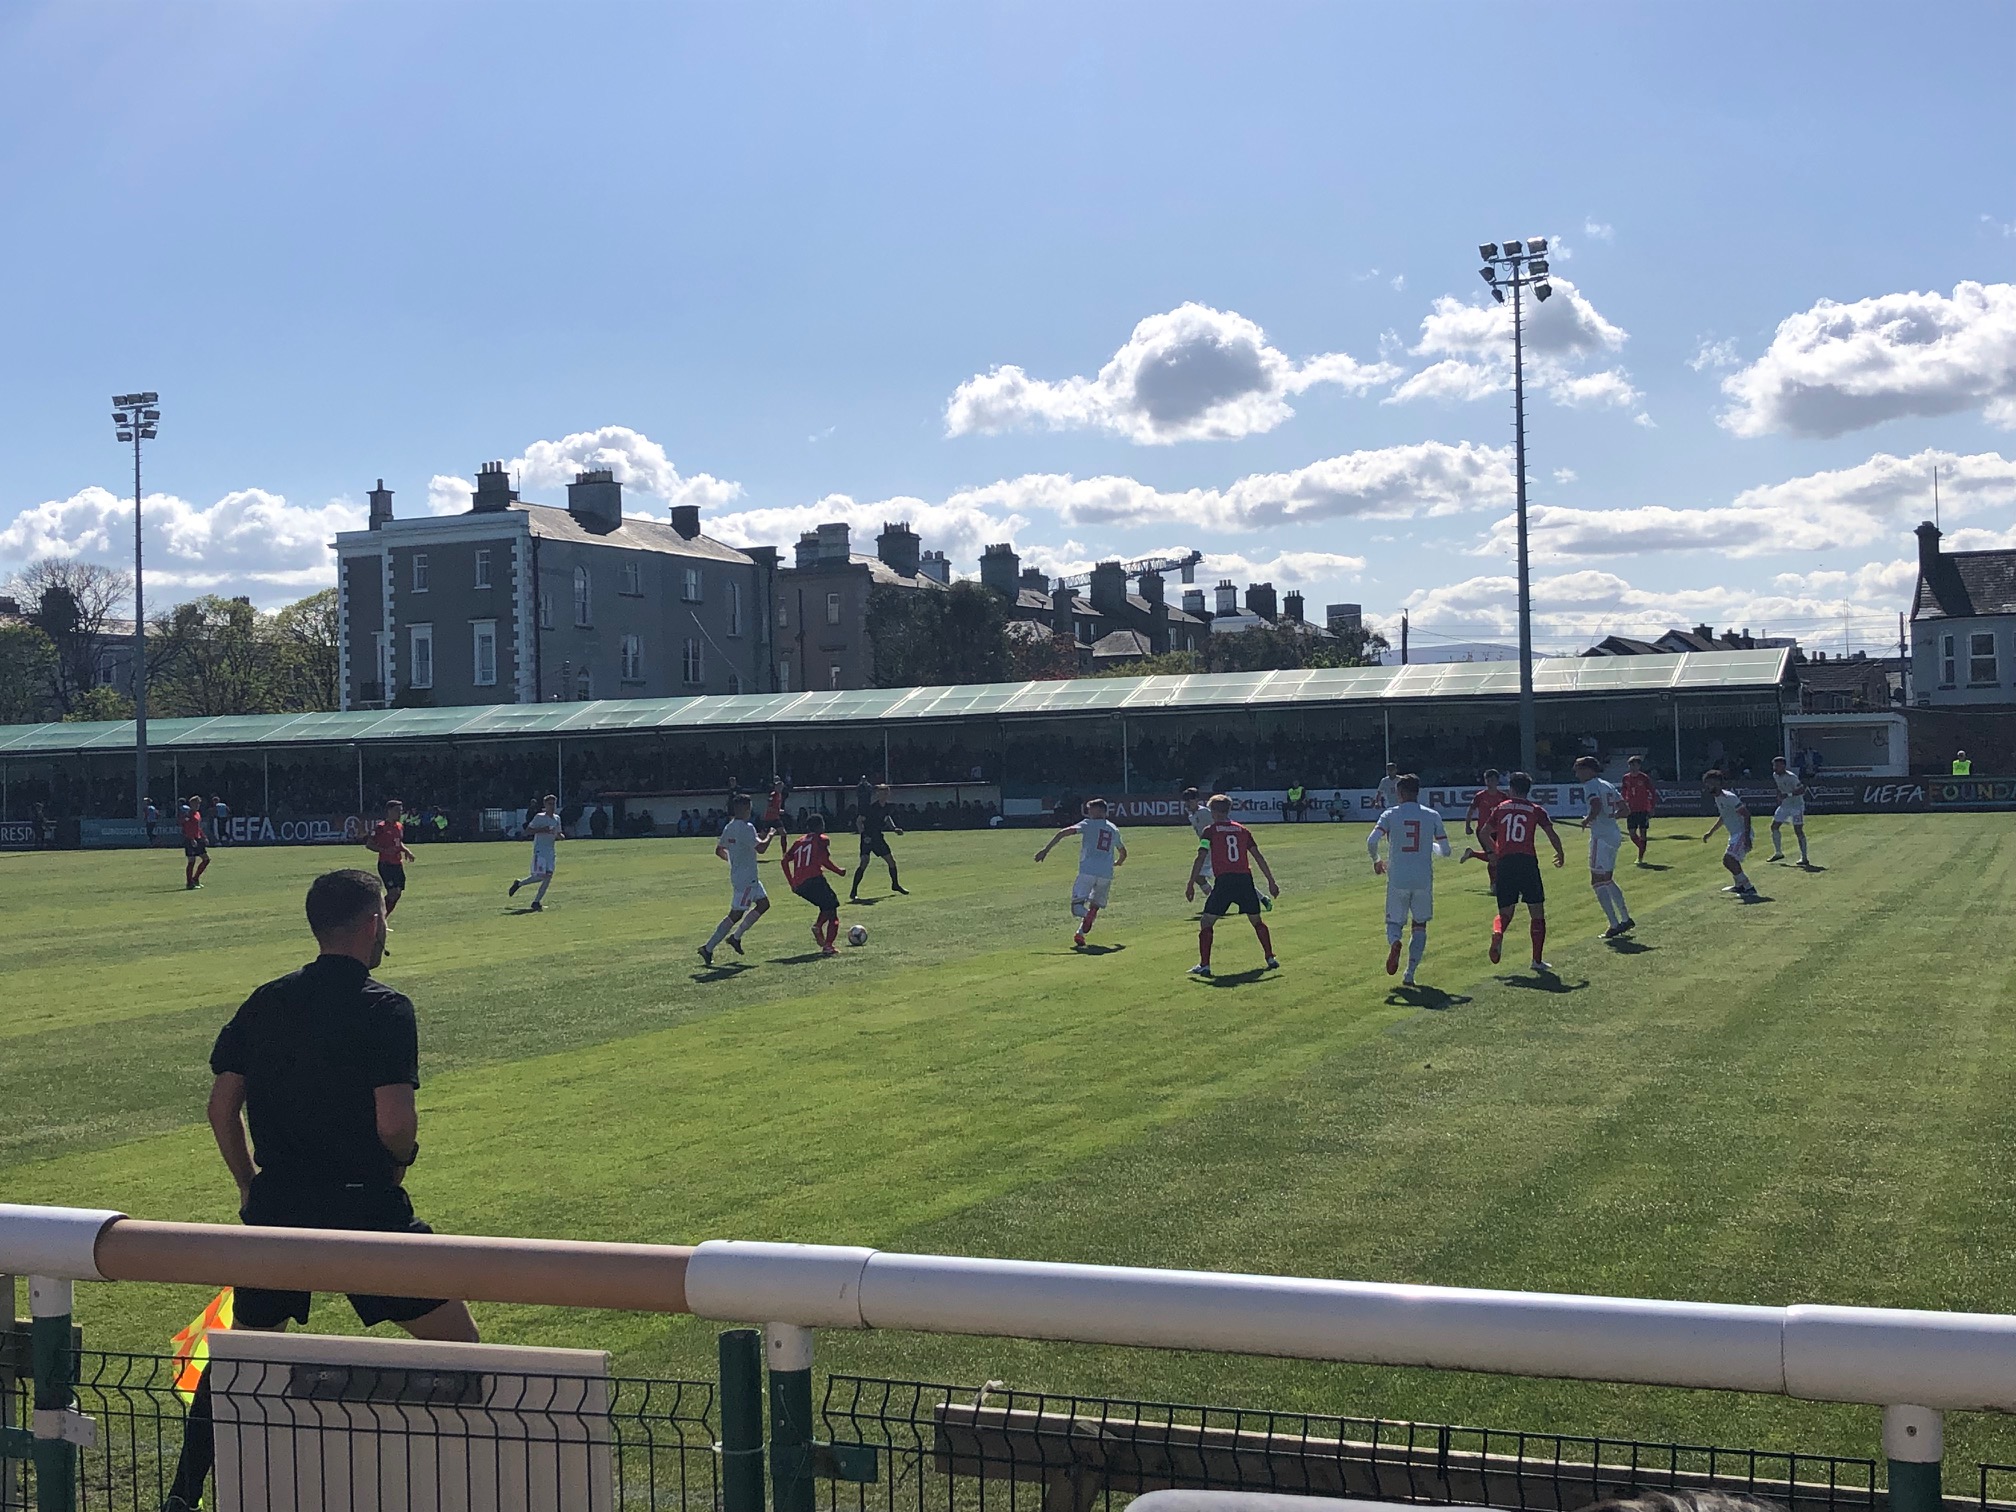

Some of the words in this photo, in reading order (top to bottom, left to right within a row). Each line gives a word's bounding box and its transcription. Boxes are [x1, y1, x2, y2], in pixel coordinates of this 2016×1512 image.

[1863, 784, 1925, 803] UEFA
[1081, 801, 1127, 817] UFA
[1097, 828, 1112, 852] 8
[1401, 820, 1420, 852] 3
[1501, 813, 1527, 842] 16
[794, 843, 812, 868] 11
[1226, 835, 1238, 863] 8
